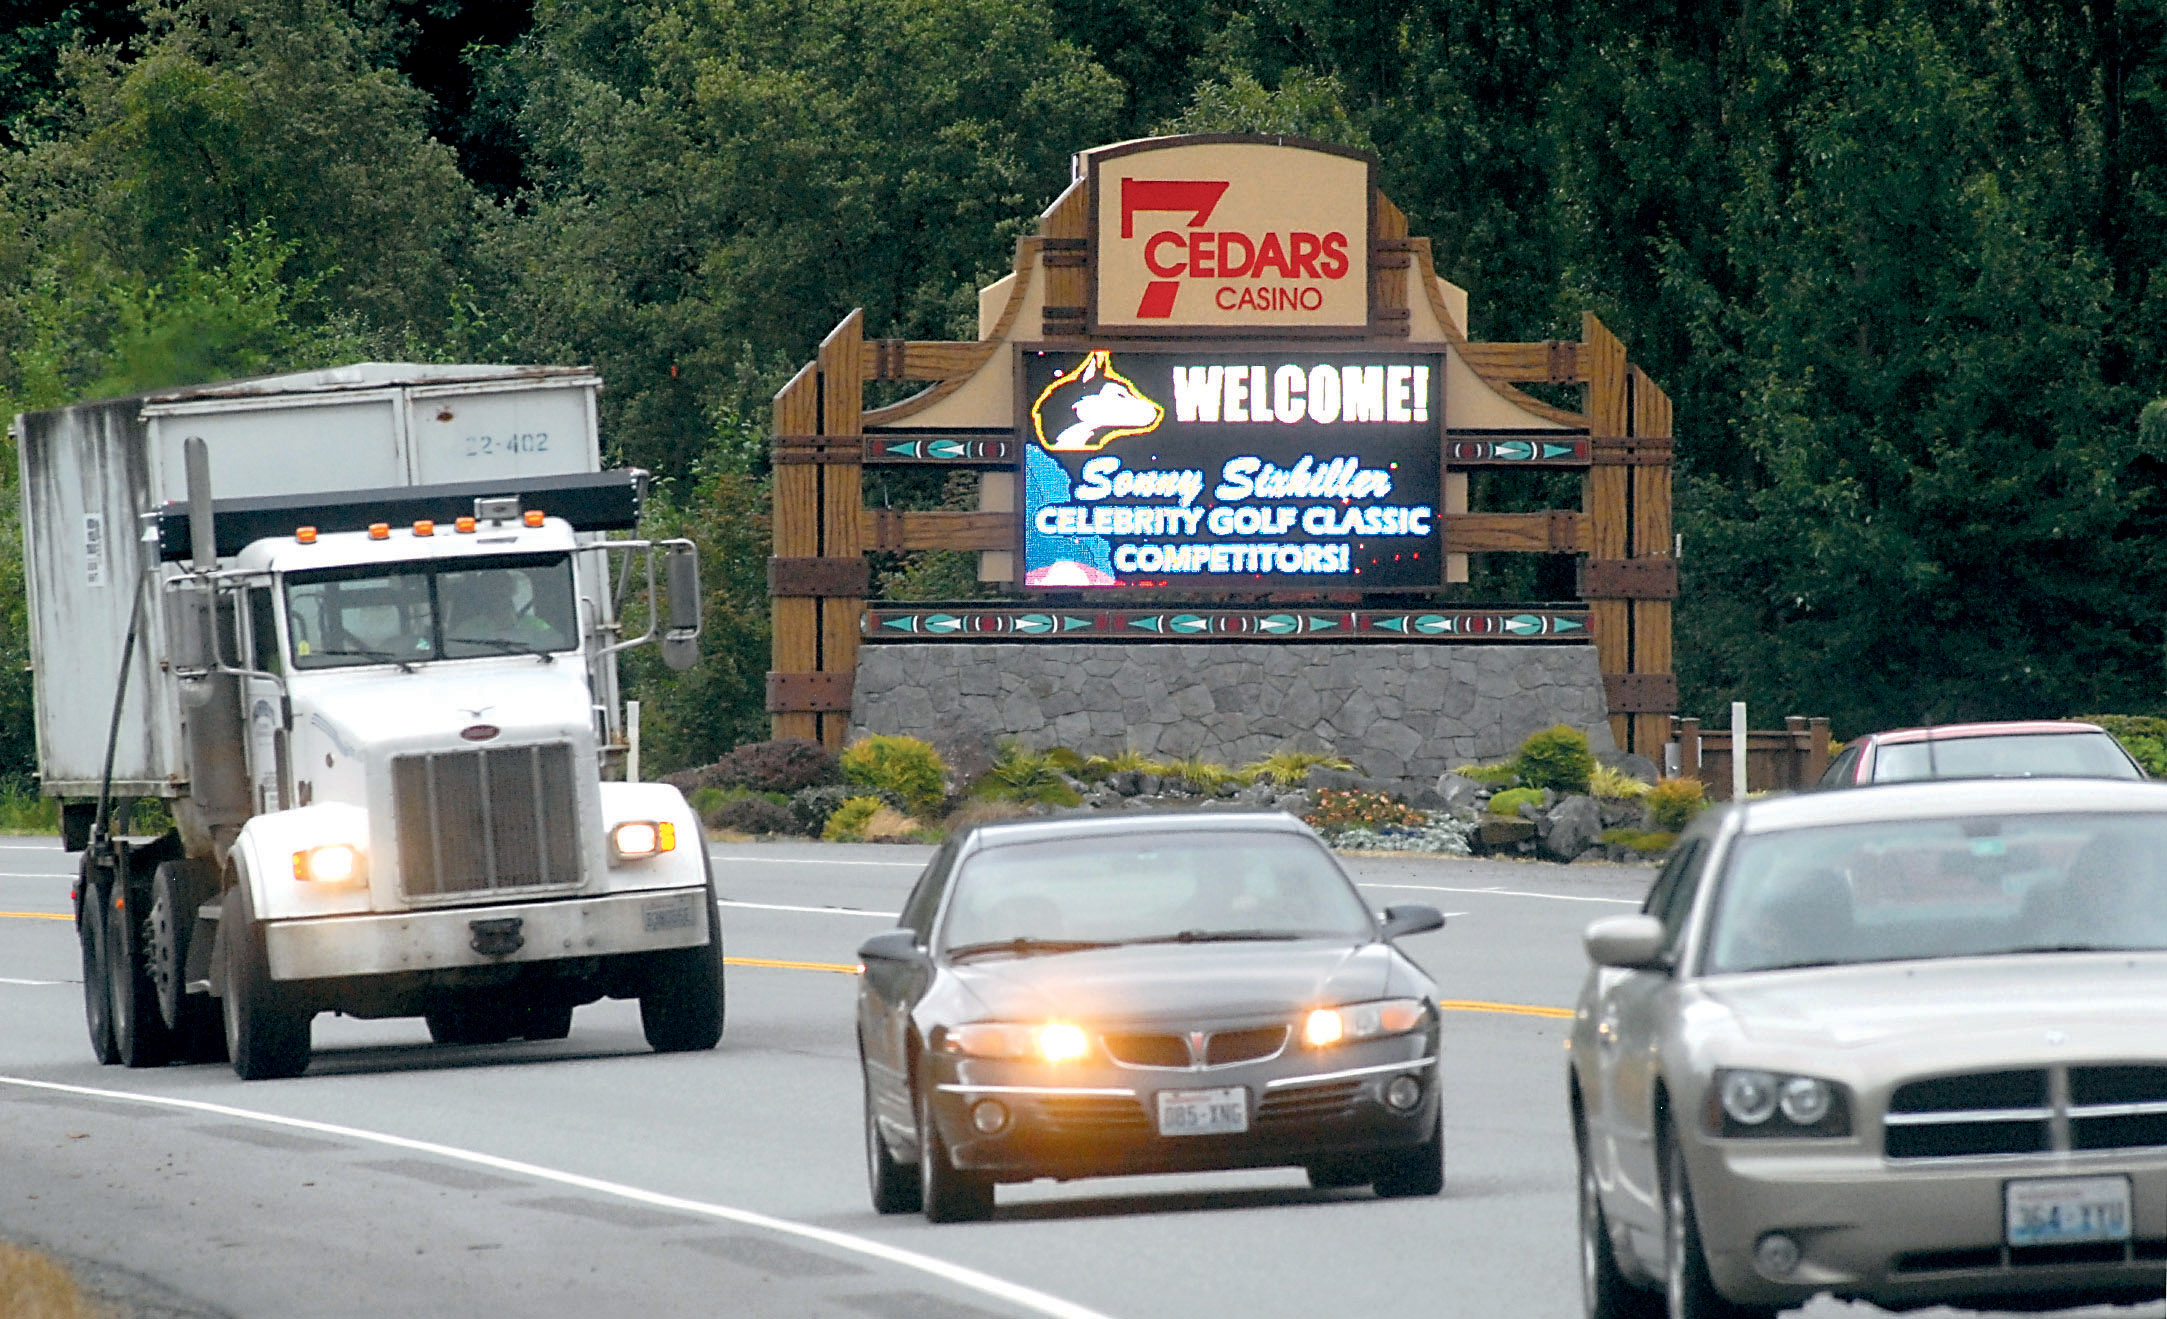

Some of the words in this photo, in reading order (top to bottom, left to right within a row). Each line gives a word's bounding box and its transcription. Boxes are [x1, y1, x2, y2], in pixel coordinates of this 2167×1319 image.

[1121, 177, 1230, 318] 7
[1144, 231, 1349, 279] CEDARS
[1215, 286, 1323, 311] CASINO
[1172, 364, 1430, 424] WELCOME!
[1074, 456, 1204, 507] Sonny
[1214, 453, 1393, 500] Sixkiller
[1035, 506, 1206, 536] CELEBRITY
[1207, 506, 1299, 536] GOLF
[1302, 506, 1431, 536] CLASSIC
[1113, 543, 1350, 573] COMPETITORS!
